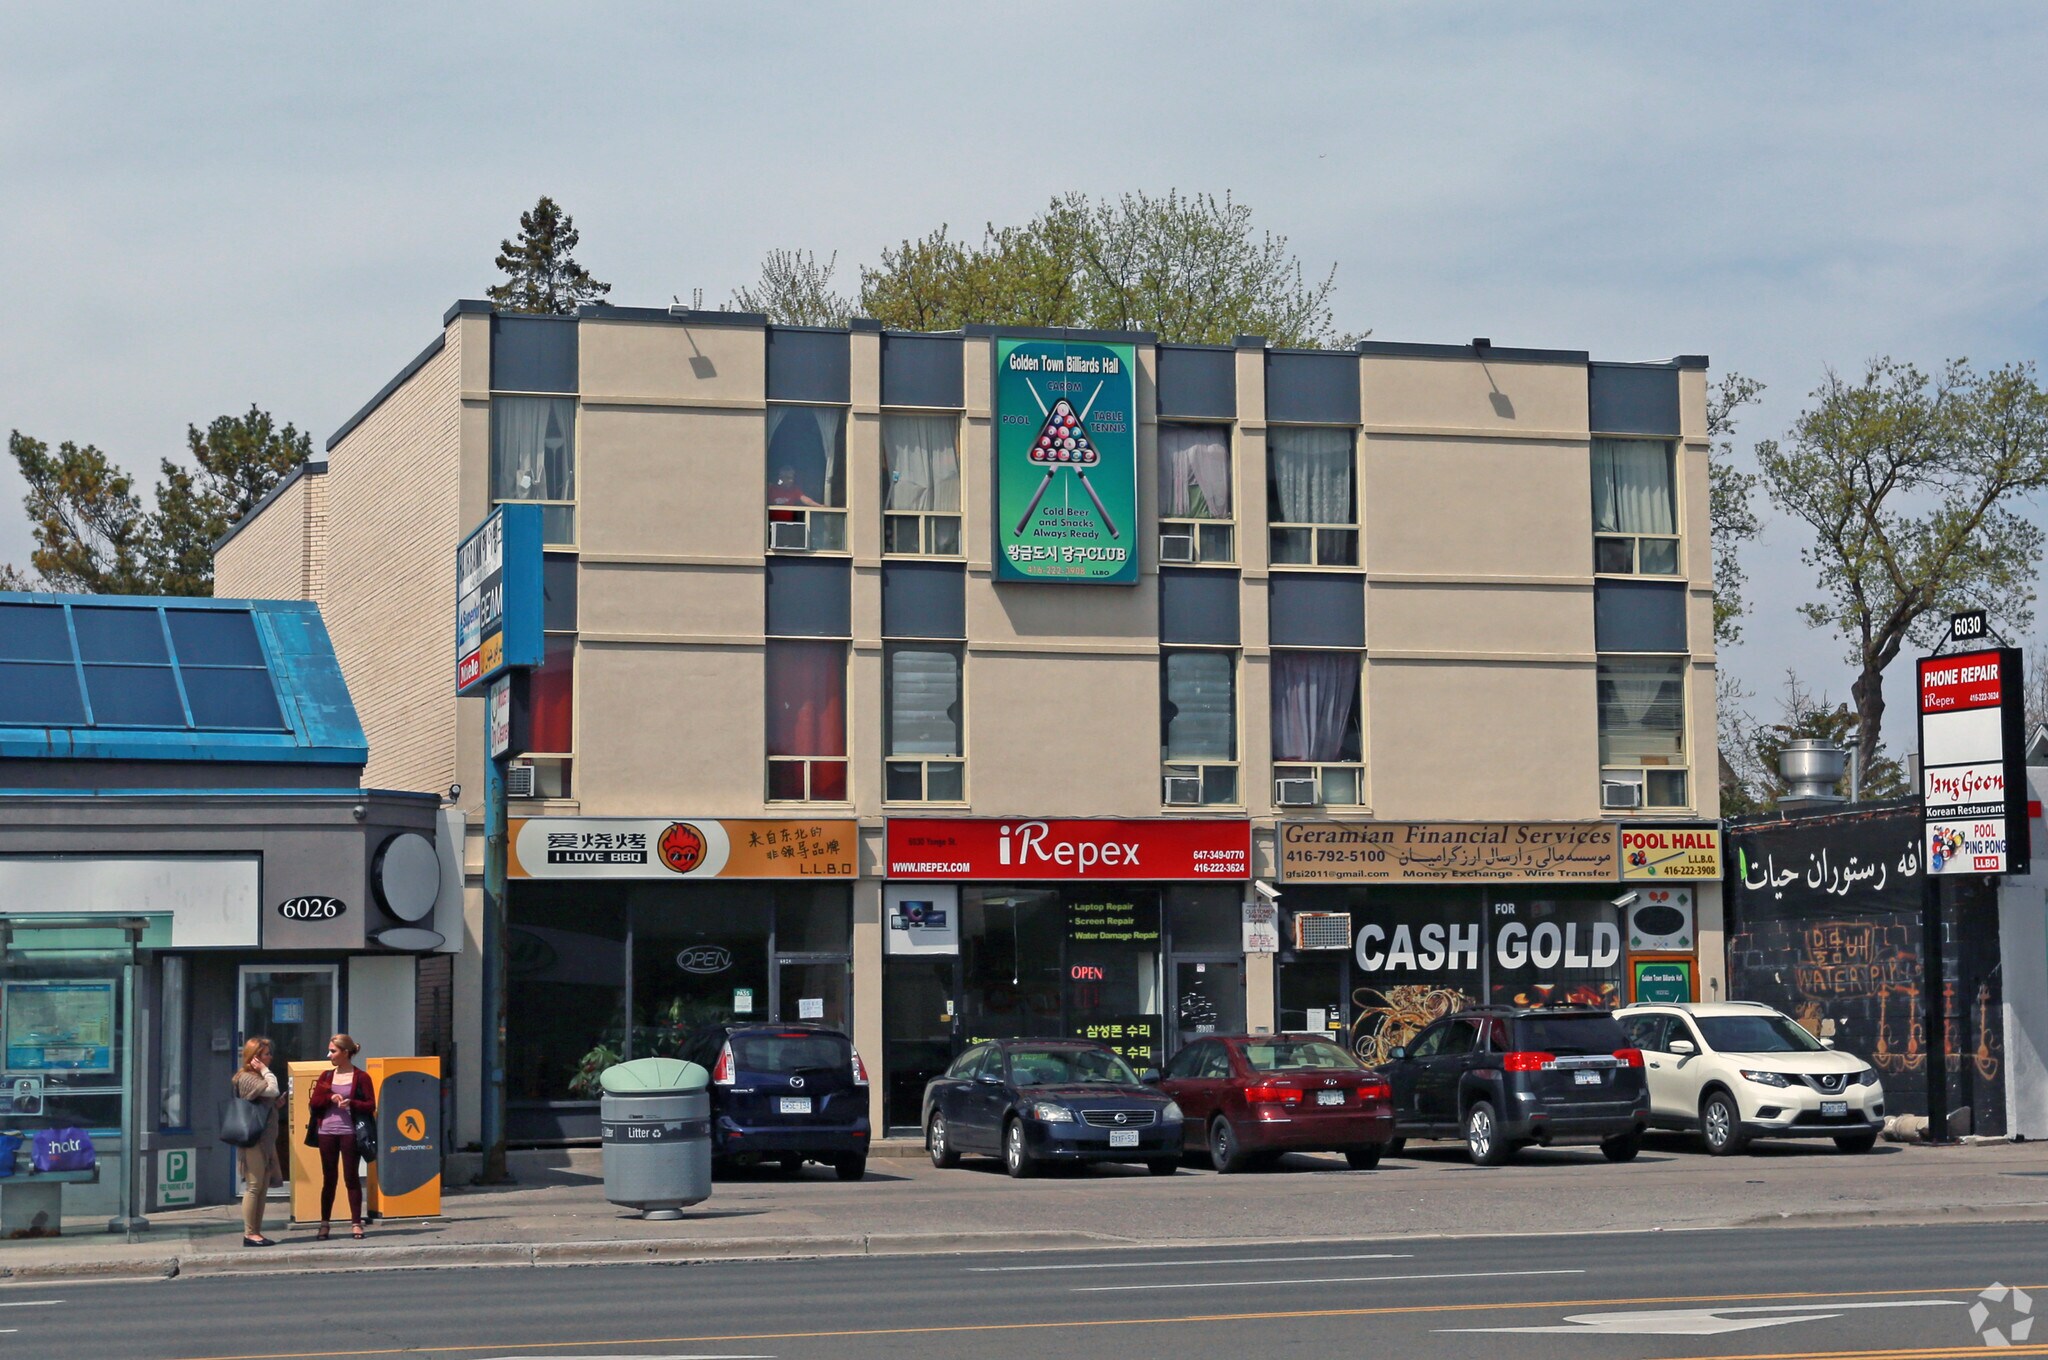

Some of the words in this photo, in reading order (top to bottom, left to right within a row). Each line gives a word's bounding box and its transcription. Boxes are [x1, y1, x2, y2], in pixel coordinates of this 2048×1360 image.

[1010, 354, 1039, 371] Golden
[1041, 355, 1064, 372] Town
[1066, 355, 1100, 373] Billiards
[1102, 357, 1119, 374] Hall
[1046, 381, 1082, 392] CAROM
[1002, 415, 1030, 425] POOL
[1093, 410, 1123, 421] TABLE
[1090, 422, 1127, 433] TENNIS
[1043, 507, 1064, 516] Cold
[1067, 507, 1089, 516] Beer
[1039, 518, 1057, 526] and
[1060, 518, 1094, 527] Snacks
[1033, 528, 1067, 539] Always
[1070, 530, 1100, 540] Ready
[1008, 544, 1058, 563] 황금도시
[1061, 546, 1128, 563] 당구CLUB
[481, 581, 502, 627] BEAM
[1954, 616, 1981, 636] 6030
[1924, 668, 1959, 688] PHONE
[1961, 664, 1999, 683] REPAIR
[1924, 693, 1955, 708] iRepex
[1926, 807, 1957, 818] Korean
[1957, 803, 2005, 816] Restaurant
[749, 826, 822, 848] 来自东北的
[1404, 825, 1508, 844] Financial
[1515, 826, 1612, 844] Services
[1974, 824, 1996, 838] POOL
[548, 833, 647, 850] 爱烧烤
[999, 820, 1141, 873] iRepex
[1622, 833, 1669, 849] POOL
[1672, 833, 1716, 849] HALL
[1193, 848, 1245, 860] 647-349-0770
[1965, 842, 1988, 855] PING
[556, 853, 560, 861] I
[566, 853, 604, 862] LOVE
[610, 853, 641, 862] BBQ
[1286, 850, 1385, 862] 416-792-5100
[1688, 855, 1715, 863] L.L.B.O.
[892, 863, 970, 873] WWW.IREPEX.COM
[1193, 861, 1245, 873] 416-222-3624
[1975, 857, 1997, 869] LLBO
[1285, 870, 1390, 880] gfsi2011@gmail.com
[1402, 870, 1448, 879] Money
[1451, 870, 1513, 879] Exchange
[1557, 869, 1611, 877] Transfer
[1664, 866, 1716, 876] 416-222-3908
[283, 898, 337, 918] 6026
[1074, 903, 1104, 912] Laptop
[1106, 903, 1134, 911] Repair
[1495, 903, 1516, 915] FOR
[1074, 917, 1105, 925] Screen
[1107, 917, 1135, 926] Repair
[1074, 932, 1099, 940] Water
[1099, 932, 1132, 941] Damage
[1133, 931, 1159, 940] Repair
[1356, 923, 1479, 972] CASH
[1497, 922, 1620, 970] GOLD
[680, 952, 731, 966] OPEN
[1071, 965, 1103, 980] OPEN
[1087, 1025, 1122, 1038] 삼성폰
[1127, 1025, 1150, 1038] 수리
[1127, 1046, 1150, 1059] 수리
[628, 1127, 650, 1138] Litter
[170, 1154, 184, 1179] P
